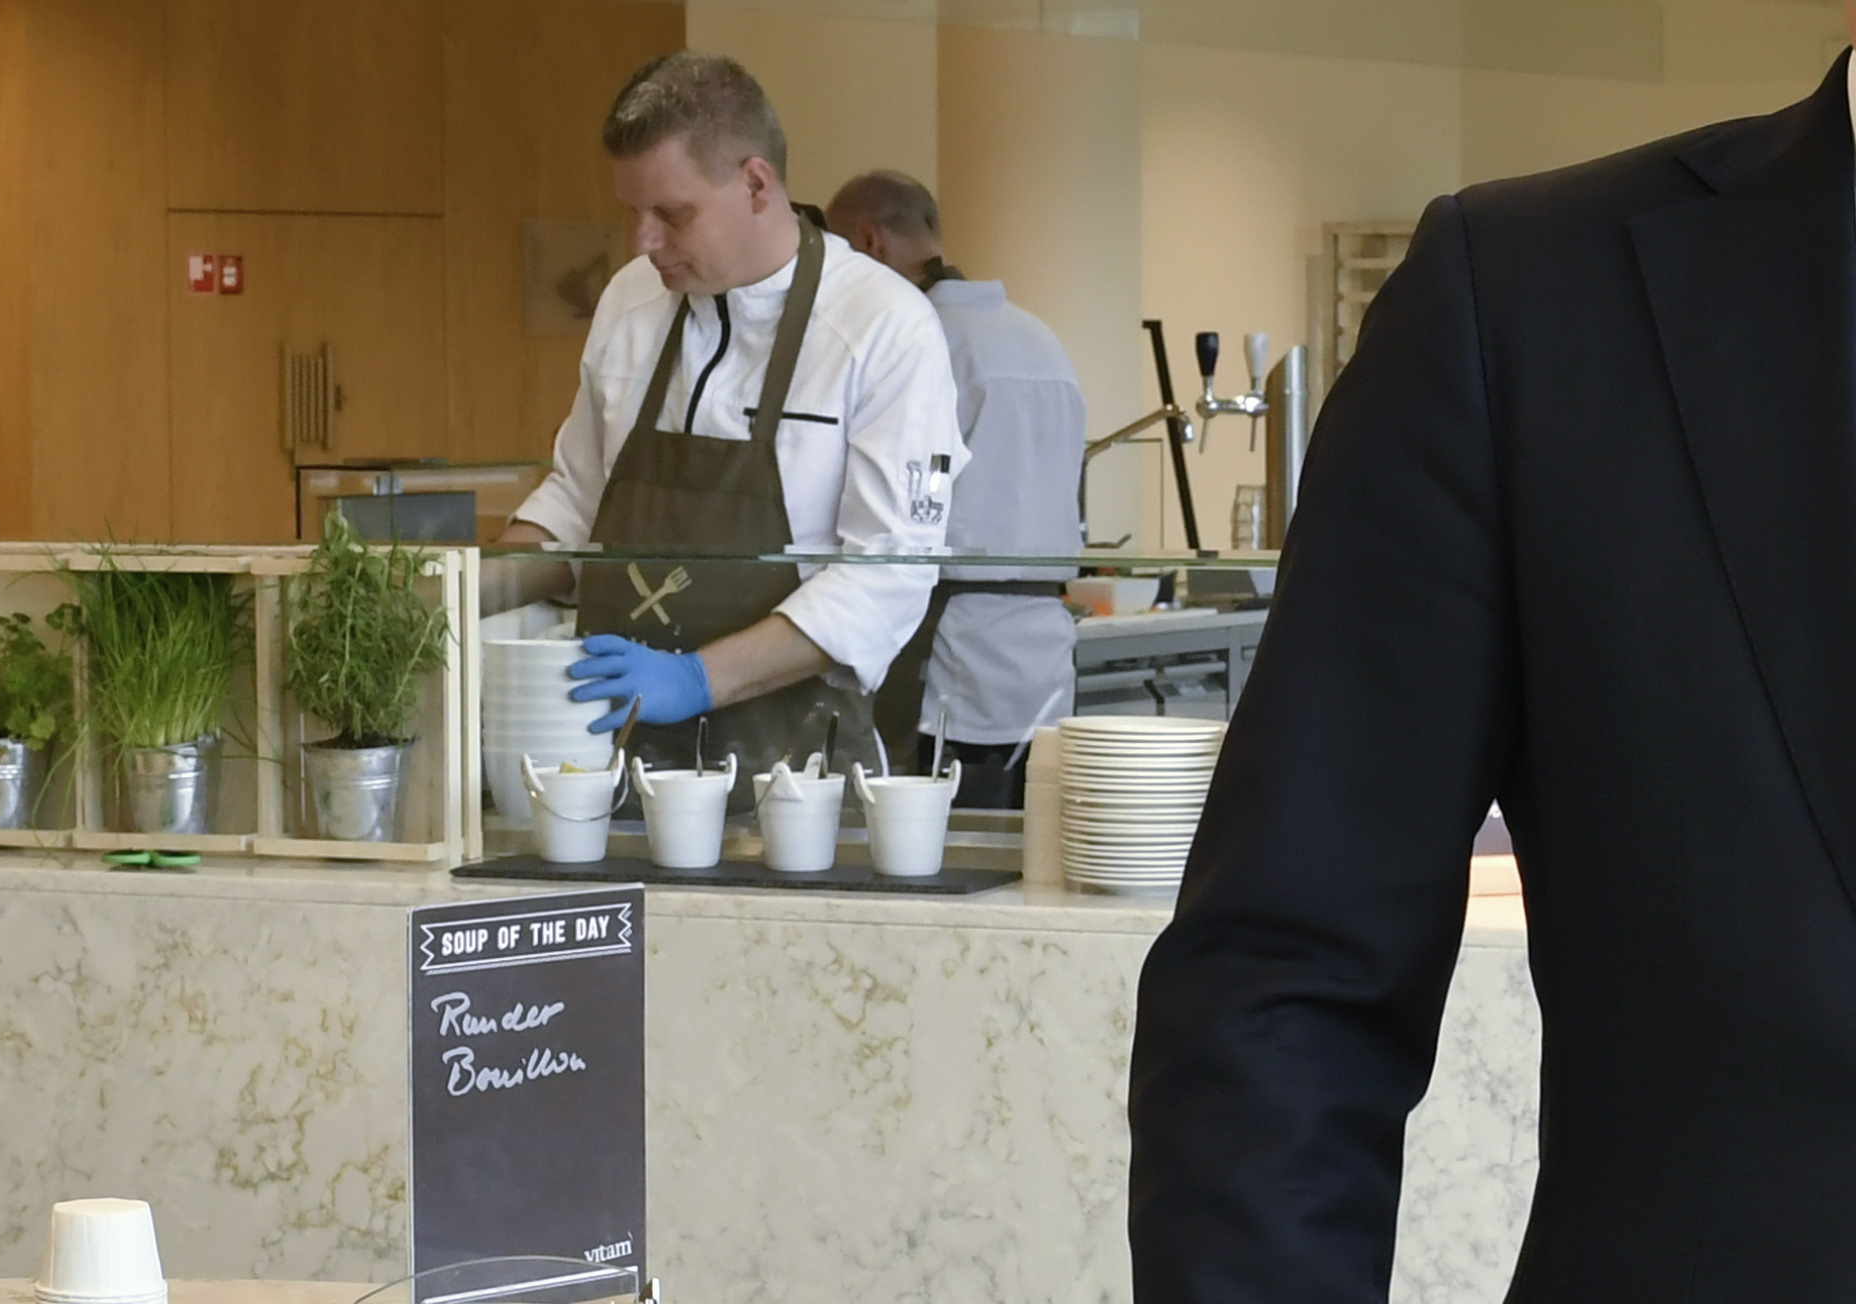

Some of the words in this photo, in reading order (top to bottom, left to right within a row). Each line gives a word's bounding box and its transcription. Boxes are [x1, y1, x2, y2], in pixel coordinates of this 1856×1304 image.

[441, 927, 489, 957] SOUP
[497, 924, 521, 950] OF
[529, 920, 566, 947] THE
[575, 914, 611, 942] DAY
